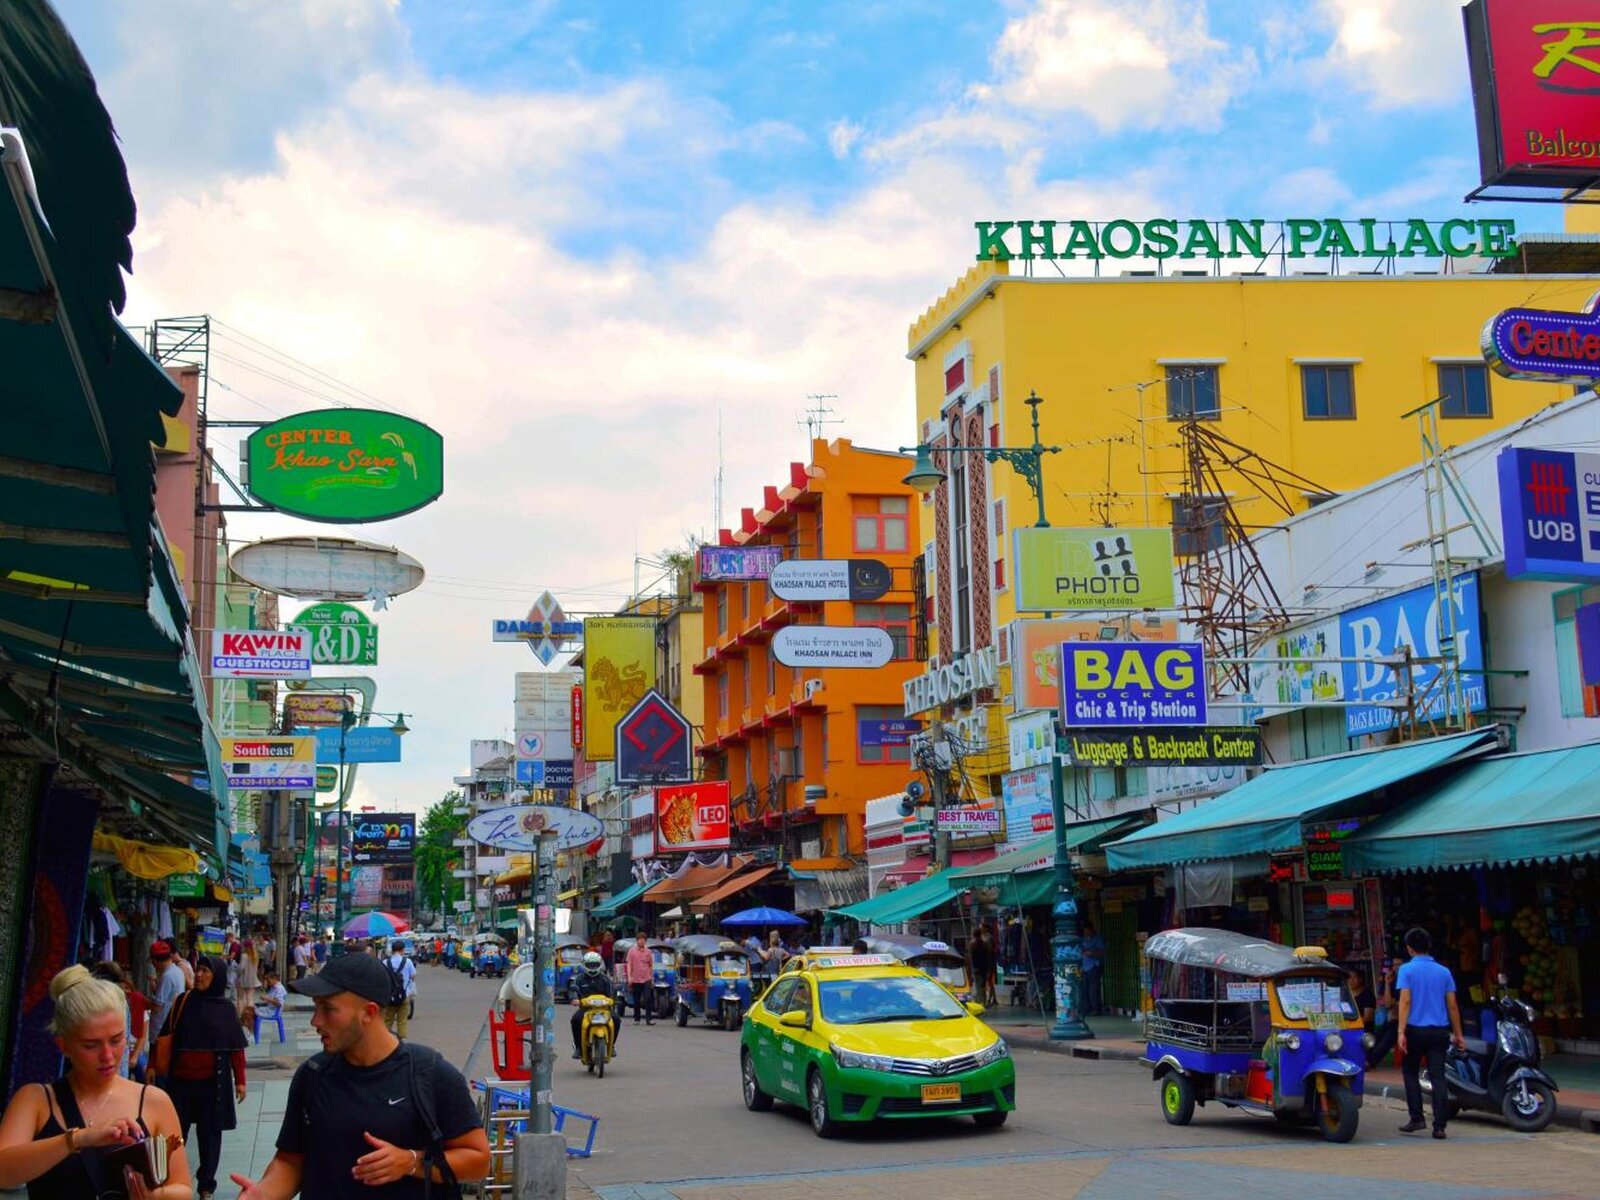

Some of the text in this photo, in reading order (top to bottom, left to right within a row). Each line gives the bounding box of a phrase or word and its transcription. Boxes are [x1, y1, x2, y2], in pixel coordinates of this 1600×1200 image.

[1526, 128, 1600, 159] Balco
[975, 217, 1518, 261] KHAOSAN PALACE
[265, 429, 353, 448] CENTER
[266, 446, 335, 471] Khao
[1527, 518, 1576, 543] UOB
[774, 580, 848, 588] KHAOSAN PALACE HOTEL
[1056, 577, 1140, 594] PHOTO
[222, 633, 302, 656] KAWIN
[1348, 586, 1470, 692] BAG
[215, 658, 308, 669] GUESTHOUSE
[795, 649, 873, 658] KHAOSAN PALACE INN
[1074, 649, 1195, 690] BAG
[903, 644, 997, 717] KHAOSAN
[1076, 691, 1196, 699] LOCKER
[1075, 700, 1197, 722] Chic & Trip Station
[234, 744, 294, 756] Southeast
[1073, 734, 1255, 766] Luggage & Backpack Center
[545, 775, 573, 784] CLINIC
[702, 807, 724, 822] LEO
[939, 811, 998, 821] BEST TRAVEL
